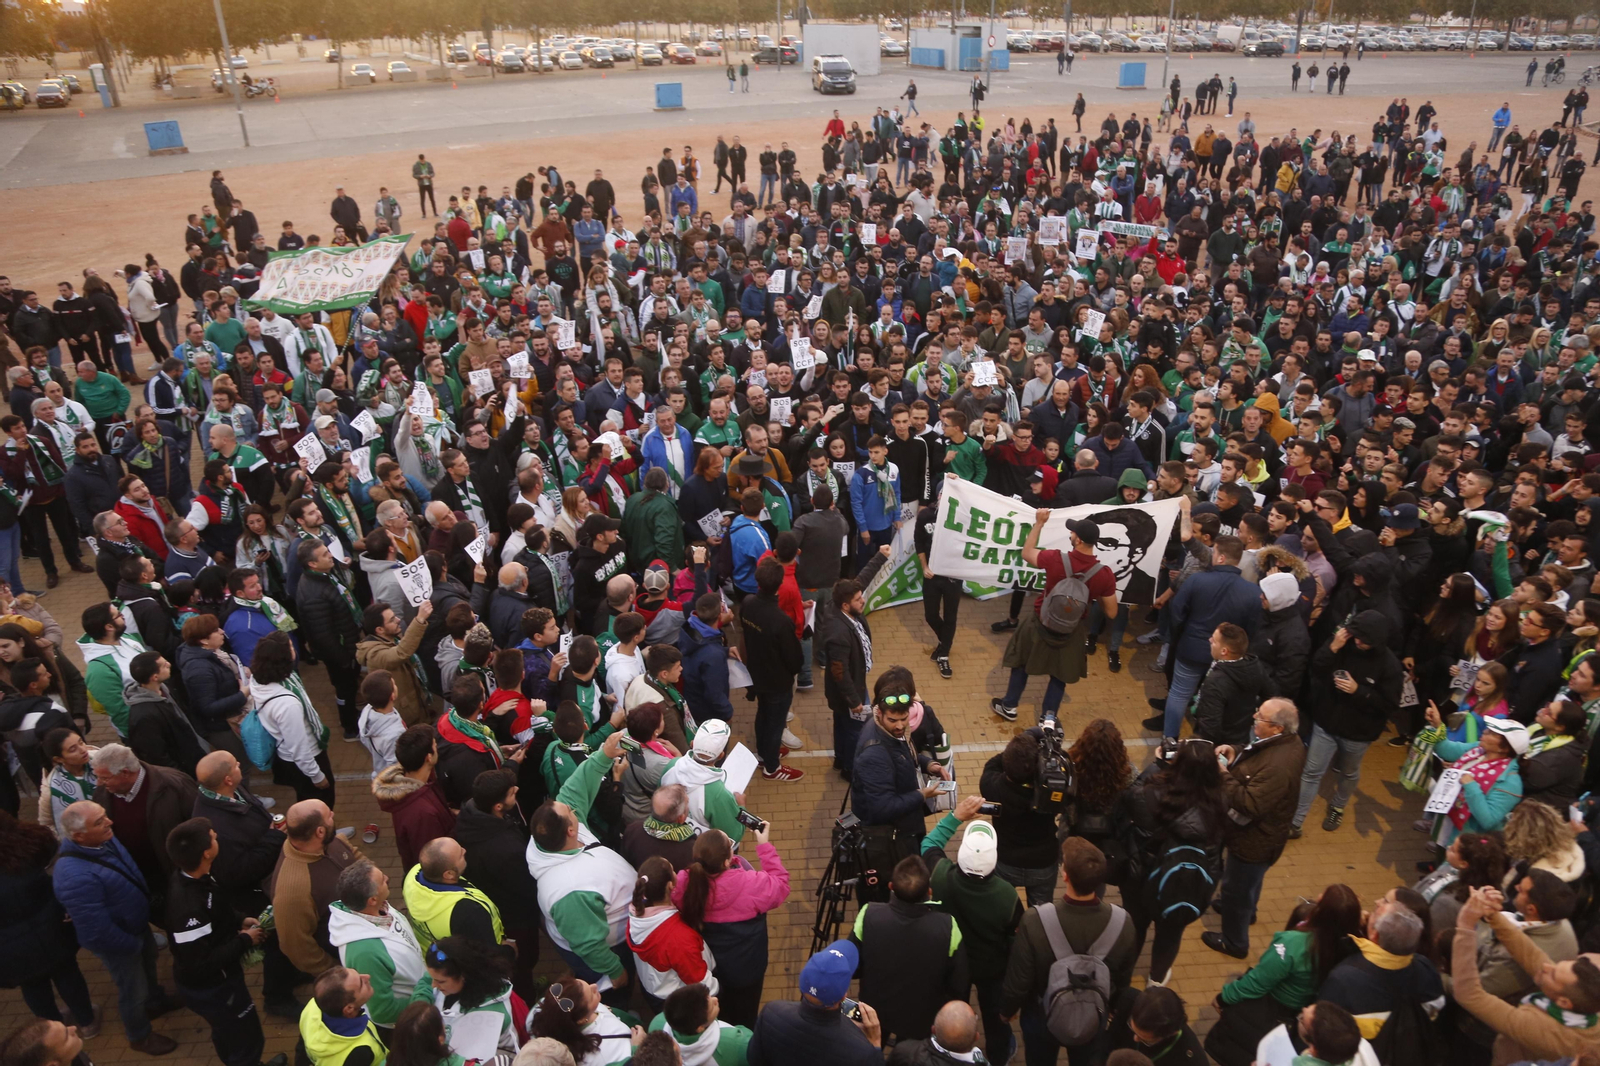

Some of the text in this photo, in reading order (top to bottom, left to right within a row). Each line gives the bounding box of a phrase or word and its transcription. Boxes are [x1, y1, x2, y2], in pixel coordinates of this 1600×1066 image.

[1088, 310, 1104, 320] SOS
[1084, 327, 1098, 336] CCF
[794, 339, 808, 347] SOS
[796, 359, 812, 368] CCF
[354, 412, 370, 426] SOS
[297, 436, 315, 451] SOS
[308, 454, 324, 470] CCF
[701, 510, 719, 525] SOS
[470, 537, 484, 554] SOS
[401, 560, 424, 578] SOS
[1463, 662, 1480, 672] SO
[1454, 679, 1472, 689] CC
[1444, 770, 1459, 780] SO
[1428, 800, 1450, 810] CCF
